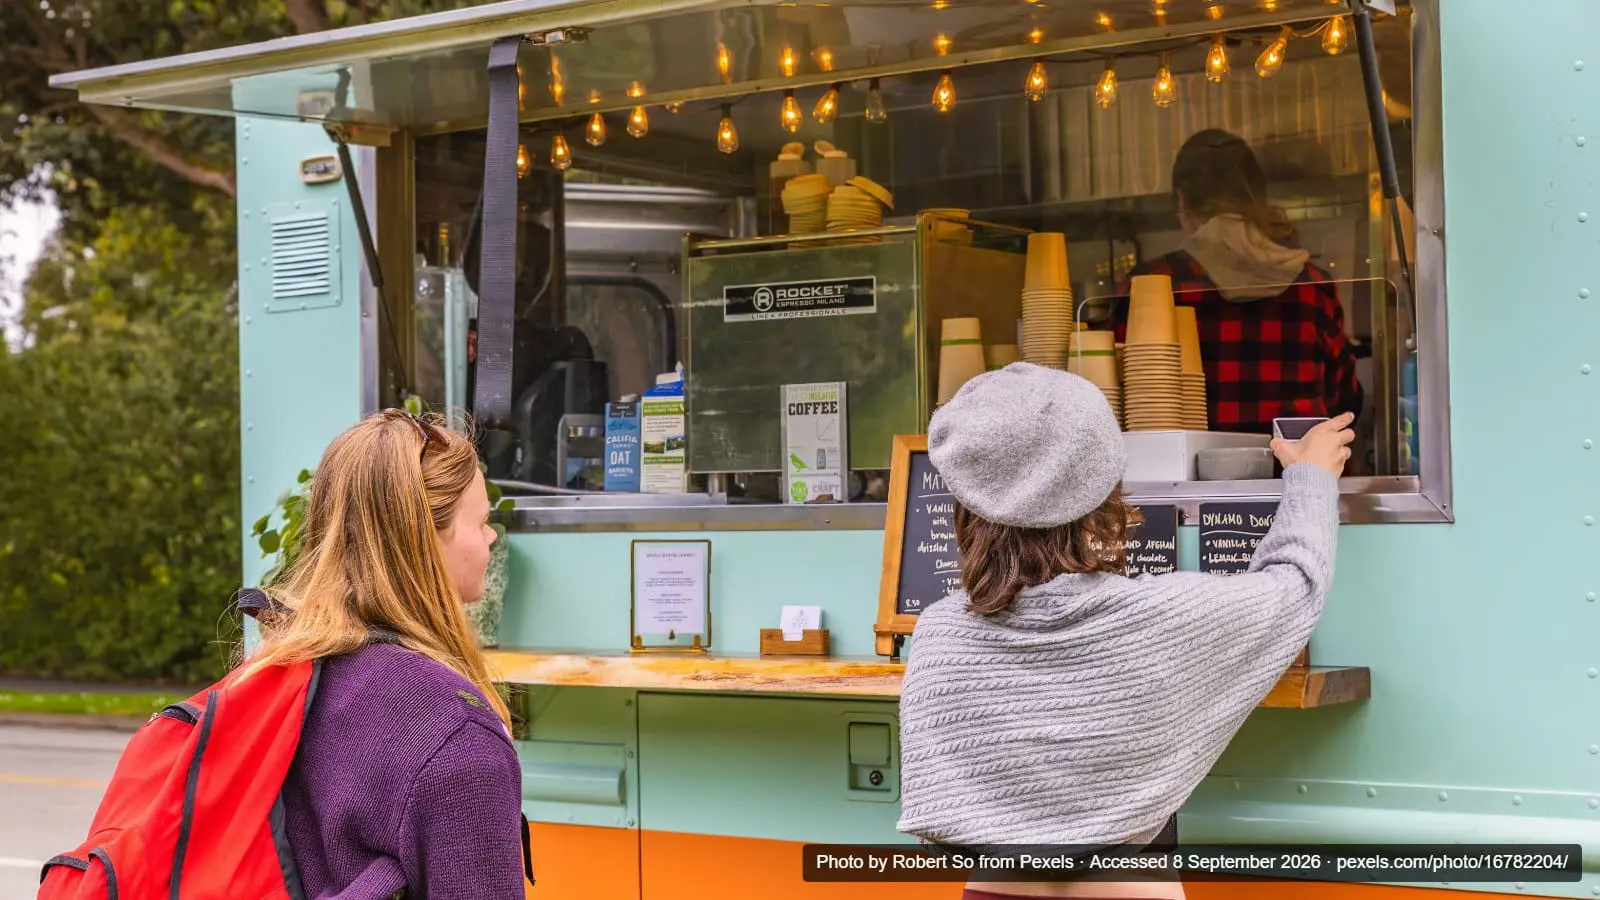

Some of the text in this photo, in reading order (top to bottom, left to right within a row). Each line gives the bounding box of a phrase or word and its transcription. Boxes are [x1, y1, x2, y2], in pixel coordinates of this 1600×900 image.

[776, 285, 844, 298] ROCKET
[776, 297, 845, 308] ESPRESSO MILANO
[778, 309, 848, 317] PROFESSIONALE
[788, 401, 838, 416] COFFEE
[606, 434, 638, 444] CALIFIA
[610, 451, 632, 465] OAT
[932, 516, 948, 526] with
[1202, 513, 1243, 526] DYNAMO
[1145, 535, 1175, 550] AFGHAN
[1212, 539, 1247, 549] VANILLA
[1208, 553, 1238, 563] LEMON
